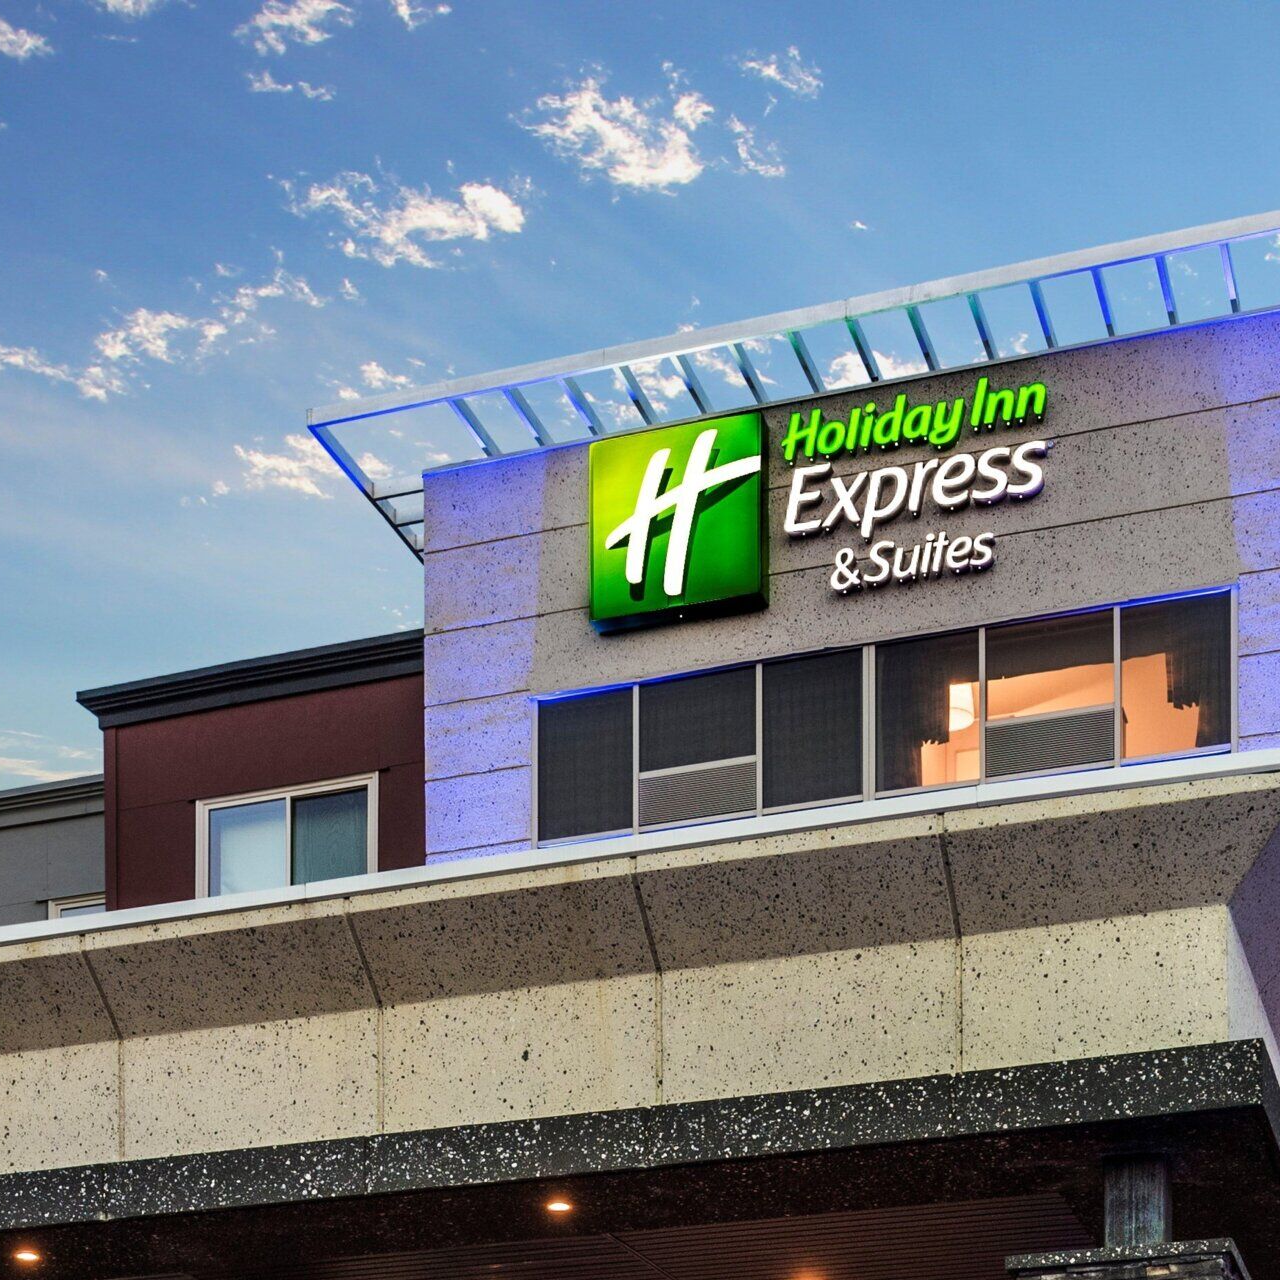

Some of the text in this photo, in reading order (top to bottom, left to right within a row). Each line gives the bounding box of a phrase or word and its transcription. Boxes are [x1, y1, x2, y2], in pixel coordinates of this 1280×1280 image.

[782, 377, 1047, 461] Holiday Inn
[783, 440, 1048, 540] Express
